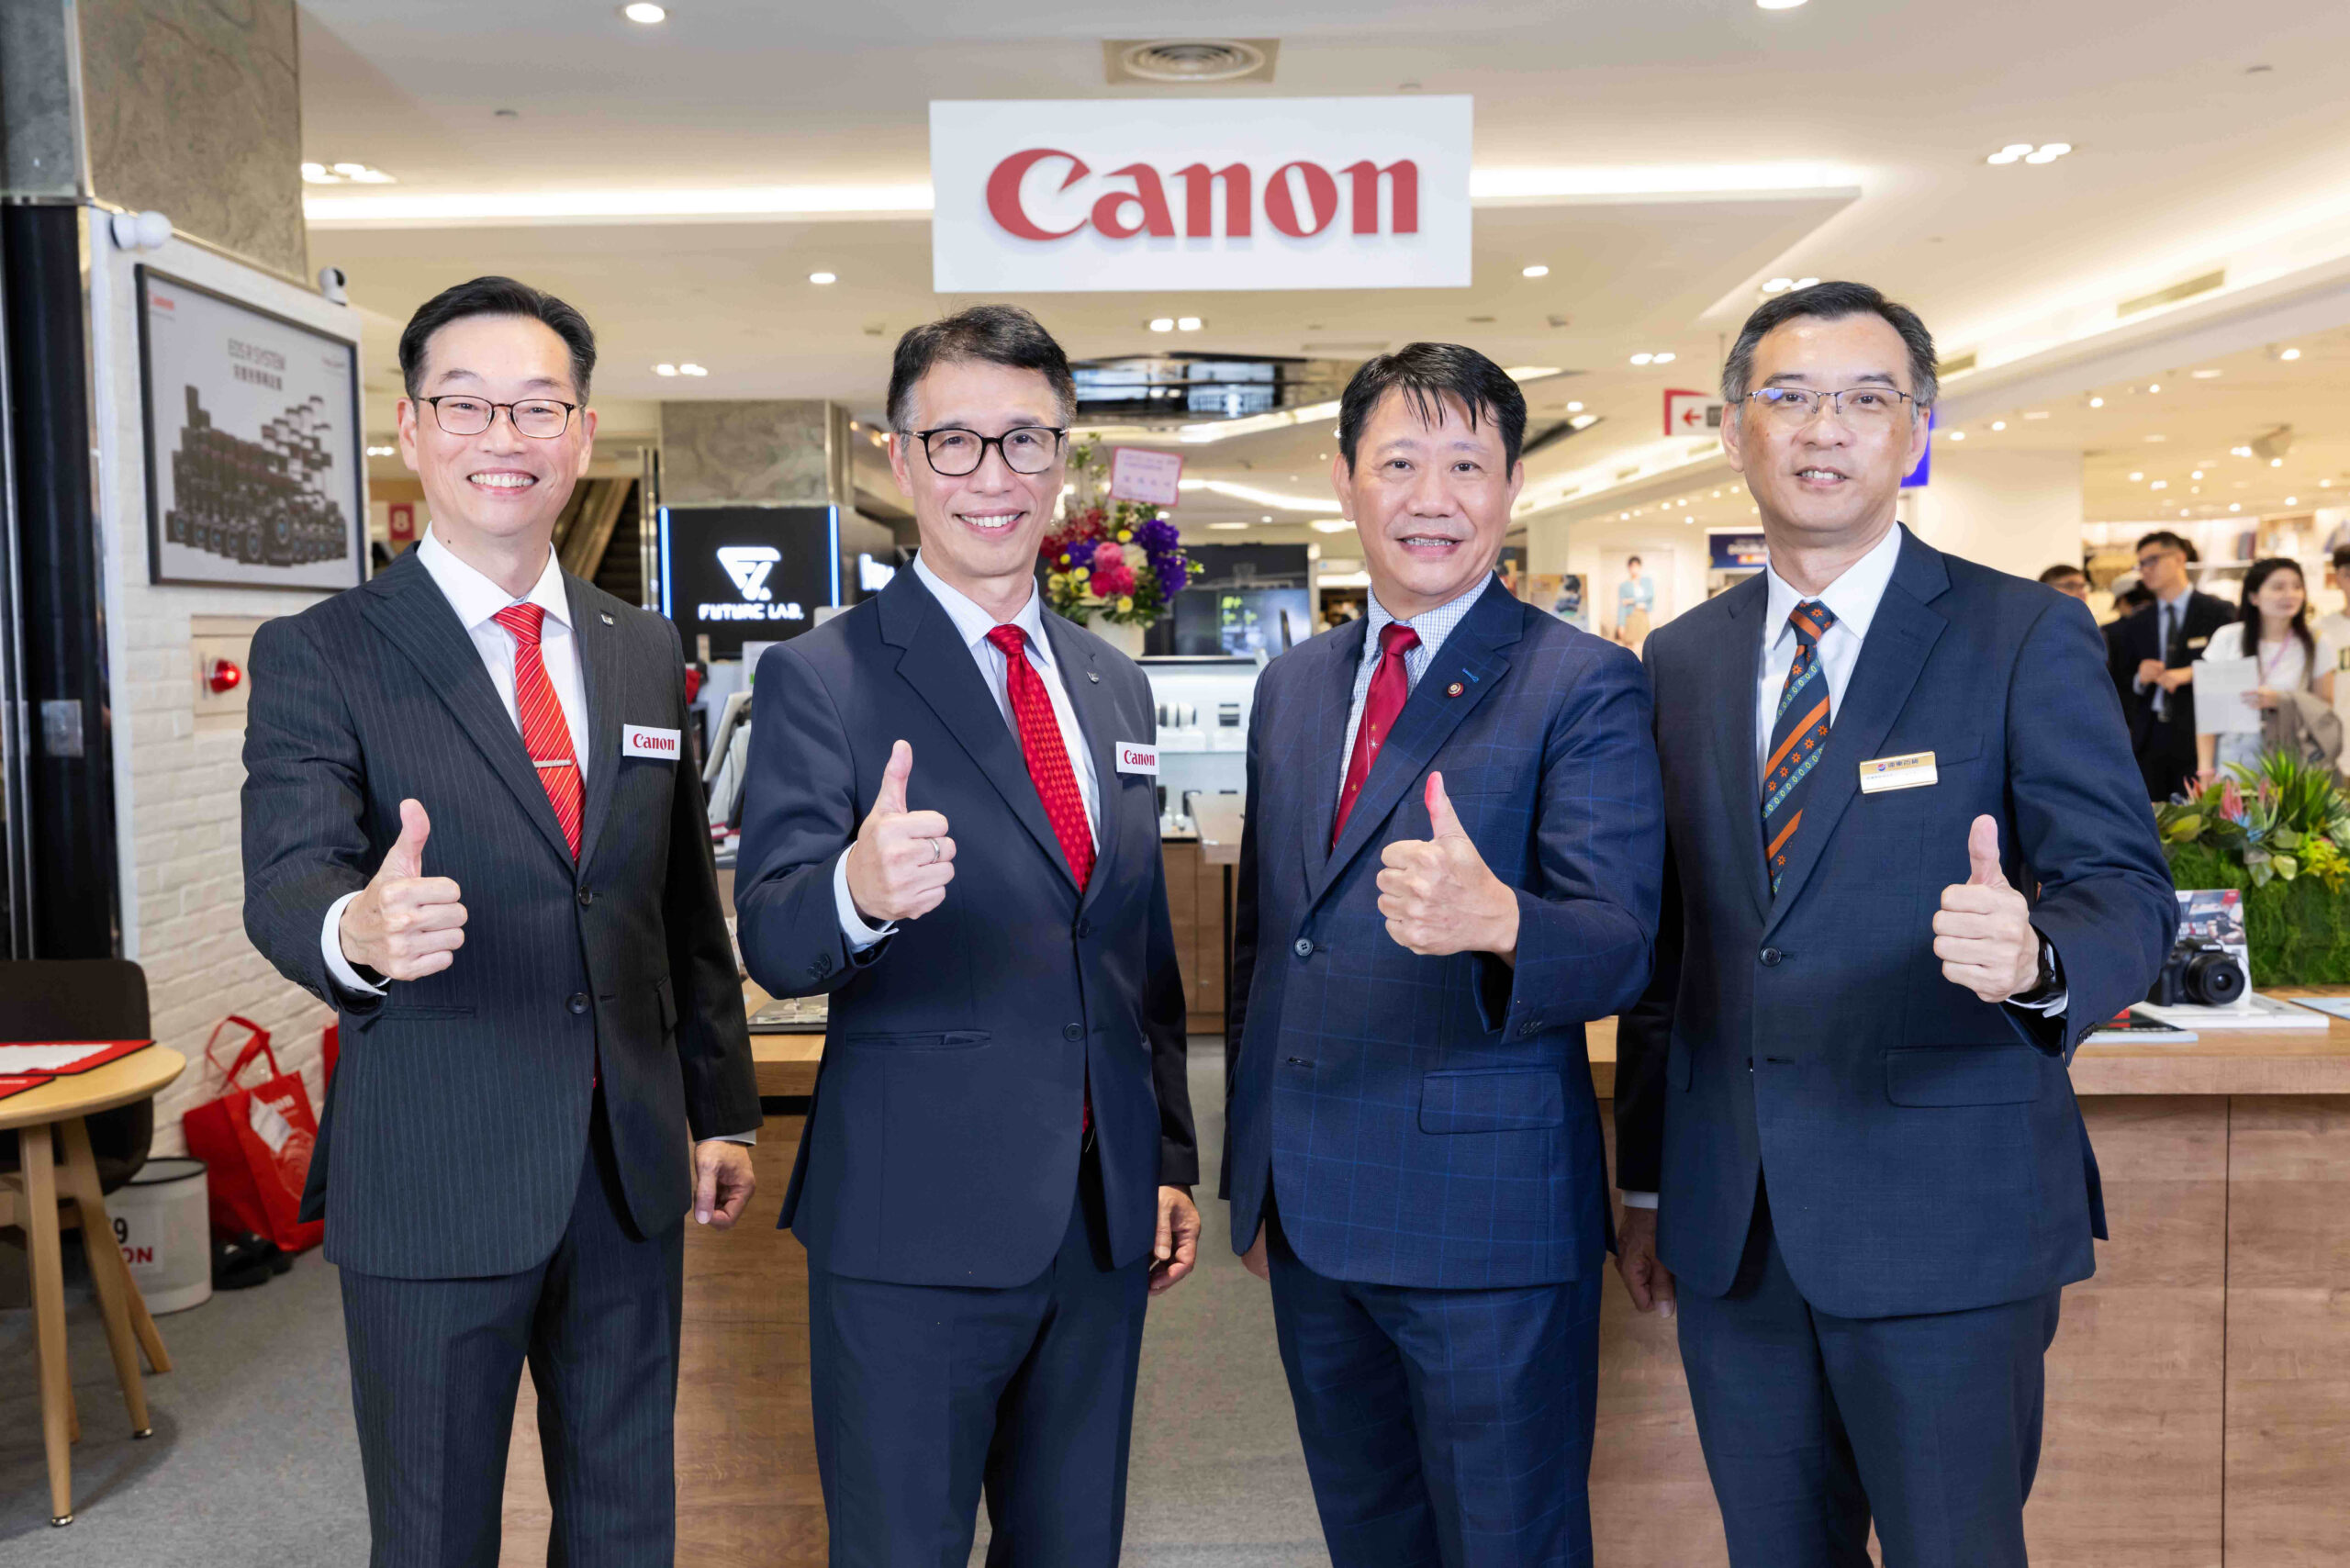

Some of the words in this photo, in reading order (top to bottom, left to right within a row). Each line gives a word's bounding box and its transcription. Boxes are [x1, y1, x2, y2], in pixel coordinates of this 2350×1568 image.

[986, 148, 1418, 241] Canon
[698, 603, 765, 621] FUTURE
[632, 733, 675, 751] Canon
[1124, 749, 1156, 767] Canon
